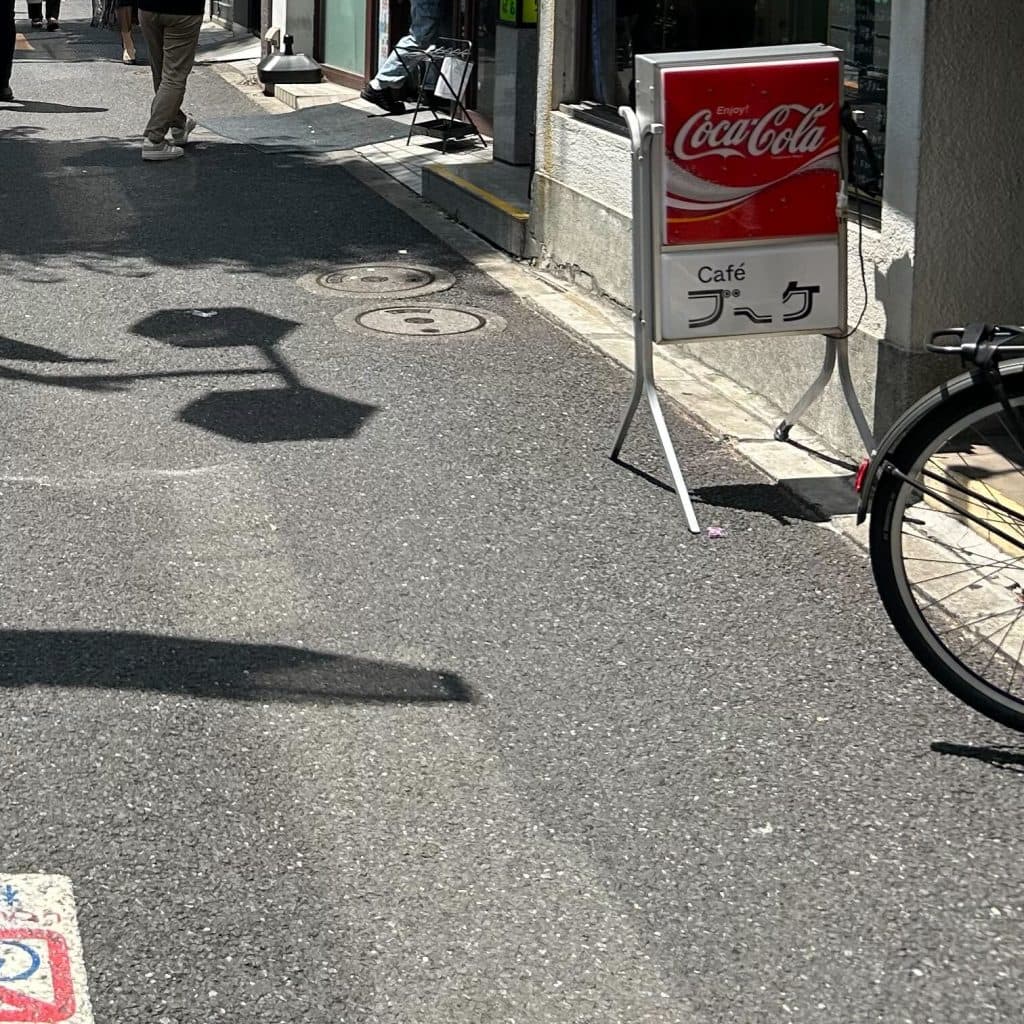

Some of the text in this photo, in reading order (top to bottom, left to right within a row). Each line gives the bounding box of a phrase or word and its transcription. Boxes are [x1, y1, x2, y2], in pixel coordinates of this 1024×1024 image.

[716, 104, 750, 115] Enjoy!
[673, 102, 834, 161] Coca-Cola
[697, 262, 746, 283] Café
[688, 281, 820, 329] ブーケ
